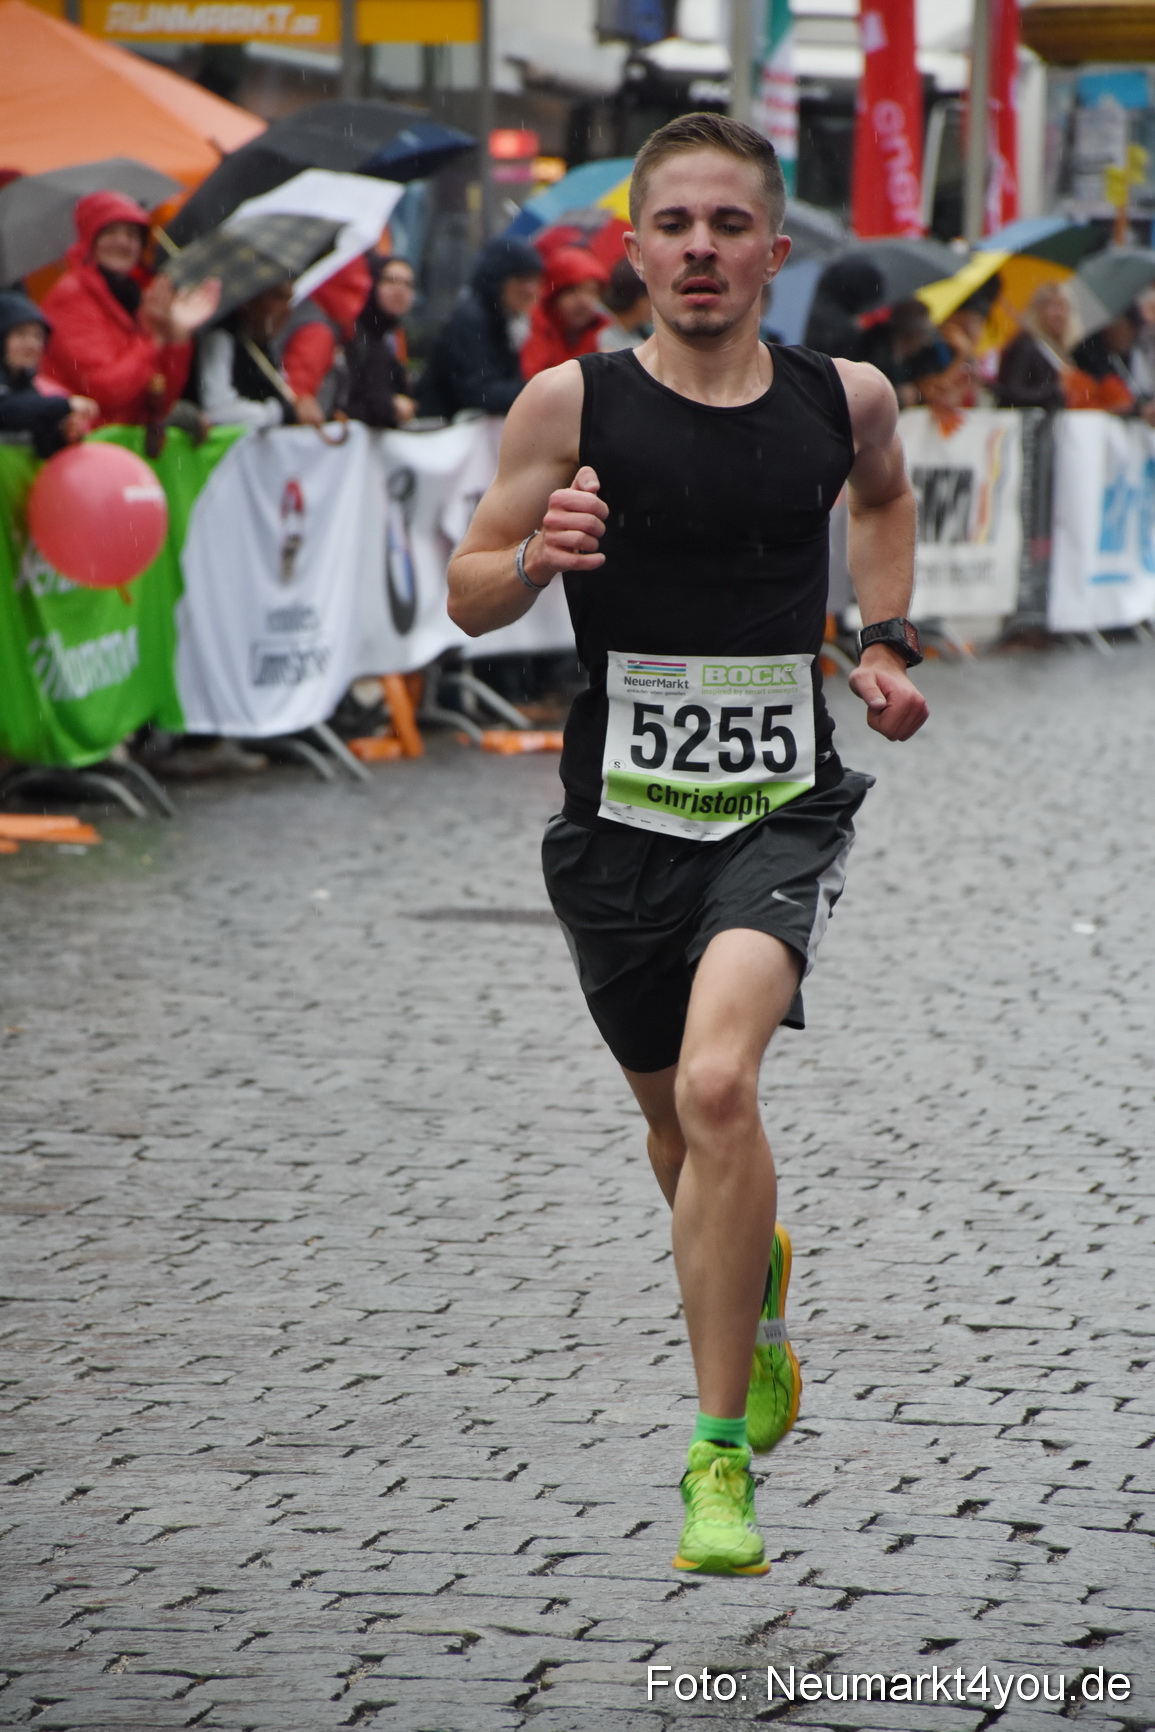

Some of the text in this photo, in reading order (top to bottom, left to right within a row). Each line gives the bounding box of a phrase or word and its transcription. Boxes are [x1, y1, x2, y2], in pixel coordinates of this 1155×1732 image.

[624, 676, 690, 689] NeuerMarkt
[702, 664, 797, 687] BOCK
[702, 688, 732, 696] inspired
[733, 688, 743, 696] by
[767, 686, 799, 695] concepts
[630, 702, 798, 774] 5255
[646, 783, 770, 820] Christoph
